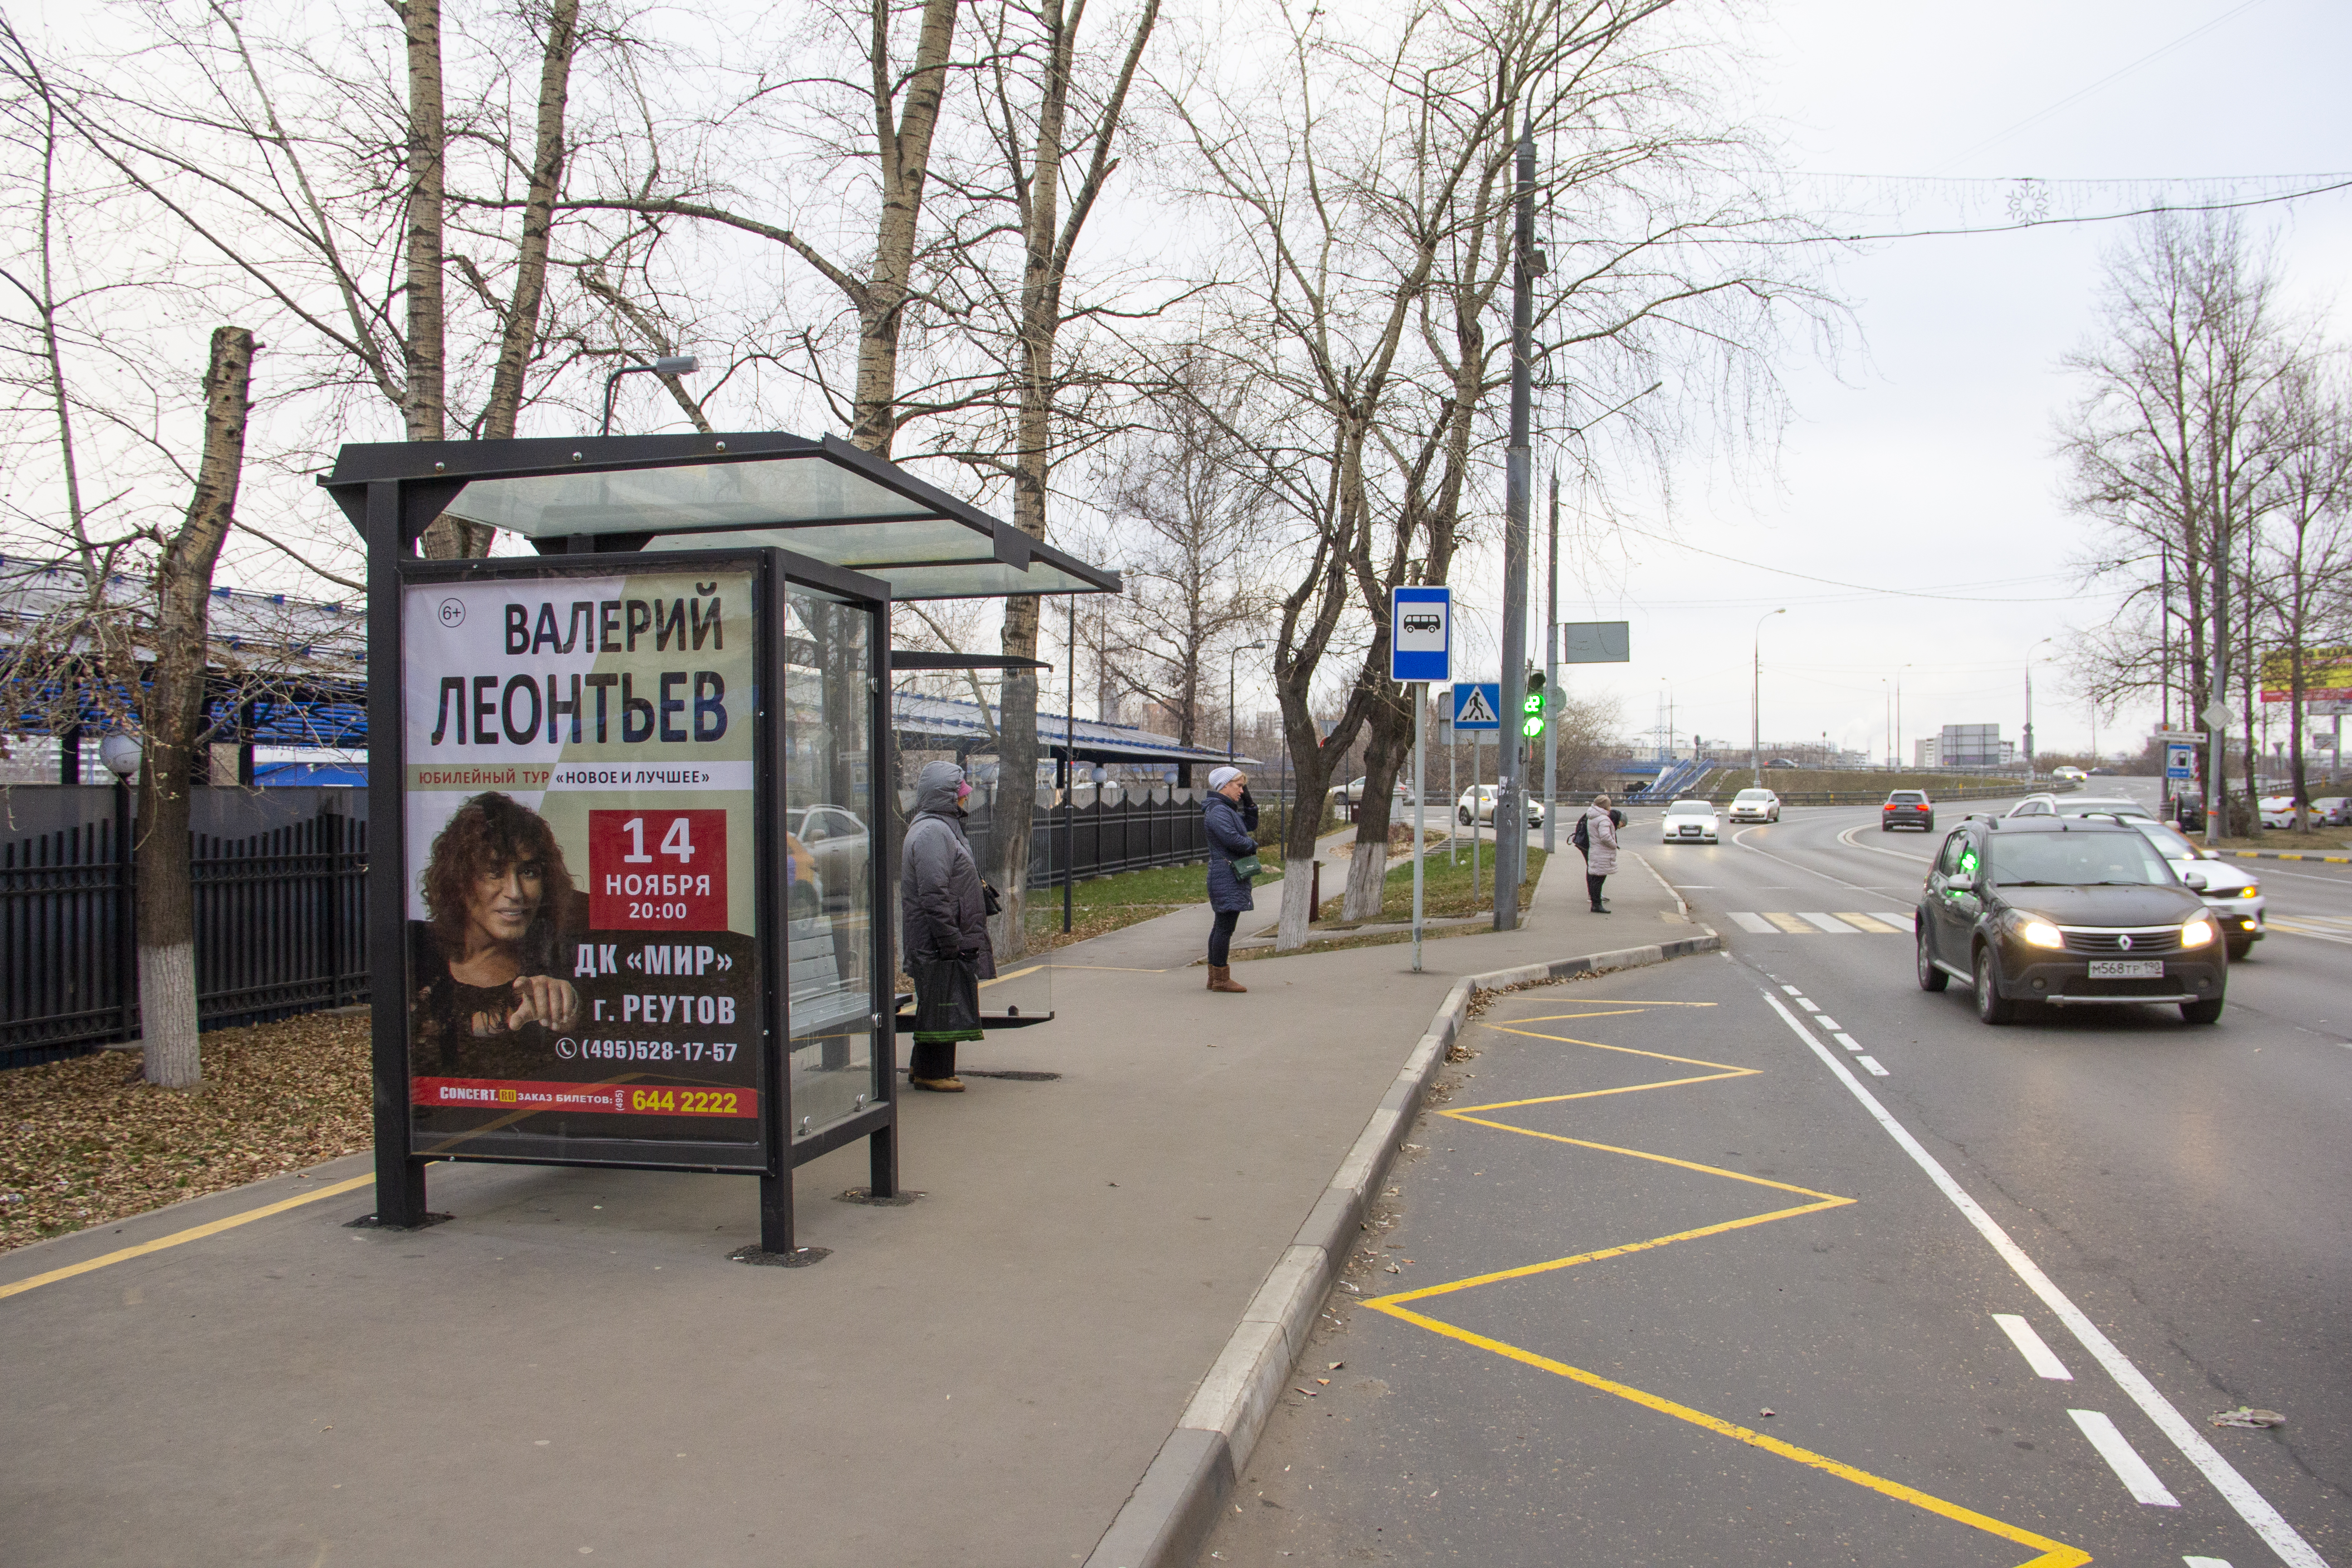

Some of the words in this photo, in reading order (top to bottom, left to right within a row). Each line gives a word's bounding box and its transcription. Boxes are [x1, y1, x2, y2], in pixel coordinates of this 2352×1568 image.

[442, 605, 461, 621] 6+
[505, 582, 723, 655] ВАЛЕРИЙ
[431, 671, 728, 745] ЛЕОНТЬЕВ
[419, 768, 516, 784] ЮБИЛЕЙНЫЙ
[523, 771, 549, 784] ТУР
[556, 771, 617, 784] «НОВОЕ
[622, 771, 632, 784] И
[635, 770, 710, 784] ЛУЧШЕЕ»
[623, 818, 696, 864] 14
[606, 874, 711, 897] НОЯБРЯ
[629, 902, 687, 919] 20:00
[574, 944, 618, 978] ДК
[627, 945, 733, 975] «МИР»
[593, 1000, 614, 1021] г.
[623, 995, 736, 1024] РЕУТОВ
[581, 1039, 738, 1062] (495)528-17-57
[517, 1093, 553, 1102] ЗАКАЗ
[556, 1094, 613, 1104] БИЛЕТОВ:
[615, 1089, 625, 1111] (495)
[632, 1090, 675, 1112] 644
[681, 1091, 738, 1113] 2222
